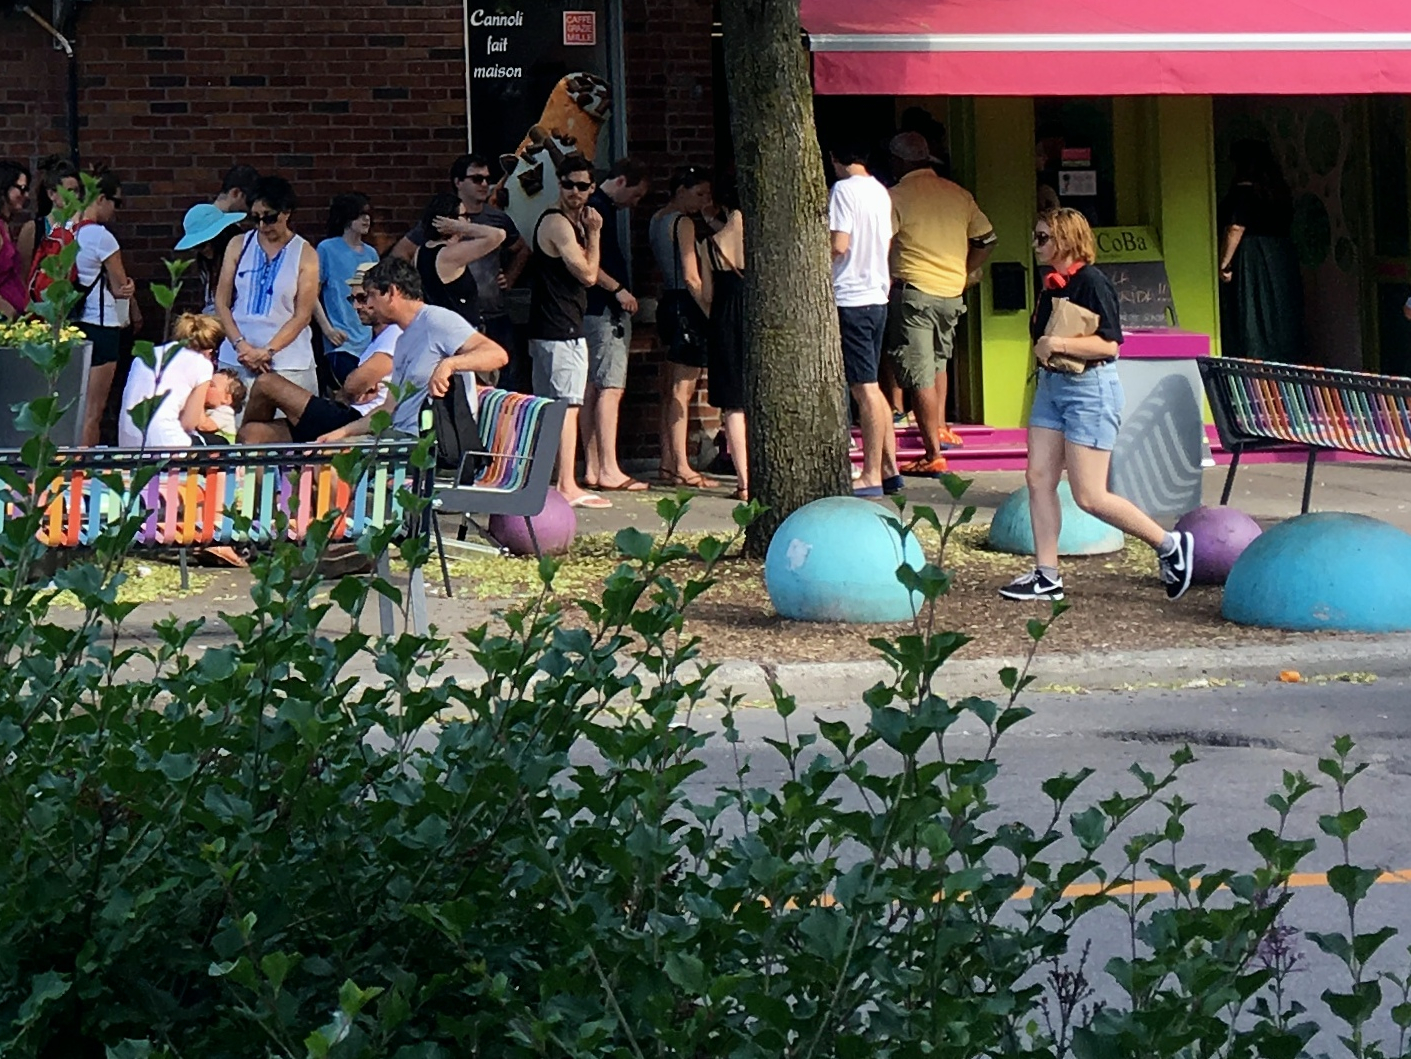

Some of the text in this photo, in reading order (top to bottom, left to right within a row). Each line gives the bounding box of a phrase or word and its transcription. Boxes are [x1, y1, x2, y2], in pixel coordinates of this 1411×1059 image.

[470, 9, 524, 27] Cannoli
[487, 35, 508, 55] fait
[567, 33, 592, 41] MILLE
[473, 64, 522, 78] maison
[1097, 231, 1148, 253] CoBa
